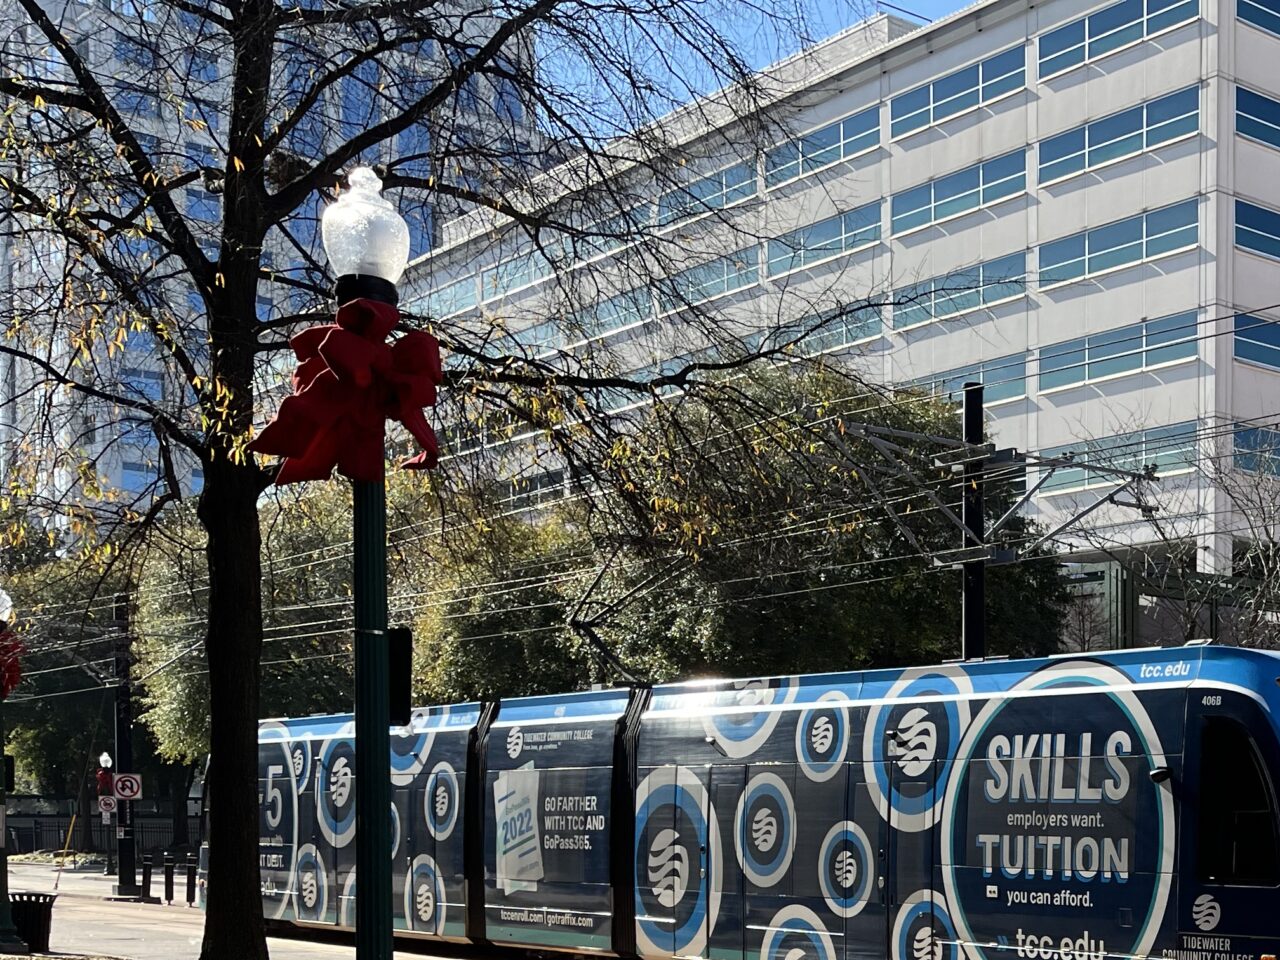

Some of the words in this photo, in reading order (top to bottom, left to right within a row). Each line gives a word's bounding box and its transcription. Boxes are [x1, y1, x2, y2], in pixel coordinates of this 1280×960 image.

[1140, 662, 1190, 678] tcc.edu
[1202, 696, 1221, 706] 406B
[984, 730, 1131, 804] SKILLS
[544, 797, 556, 811] GO
[557, 796, 597, 811] FARTHER
[502, 808, 533, 845] 2022
[544, 816, 566, 830] WITH
[567, 816, 584, 830] TCC
[585, 815, 605, 831] AND
[1007, 810, 1068, 830] employers
[1071, 812, 1105, 827] want.
[544, 835, 592, 850] GoPass365.
[976, 834, 1129, 883] TUITION
[1007, 890, 1028, 906] you
[1029, 892, 1051, 904] can
[1053, 890, 1093, 907] afford.
[500, 909, 543, 922] tccenroll.com
[1183, 936, 1231, 951] TIDEWATER
